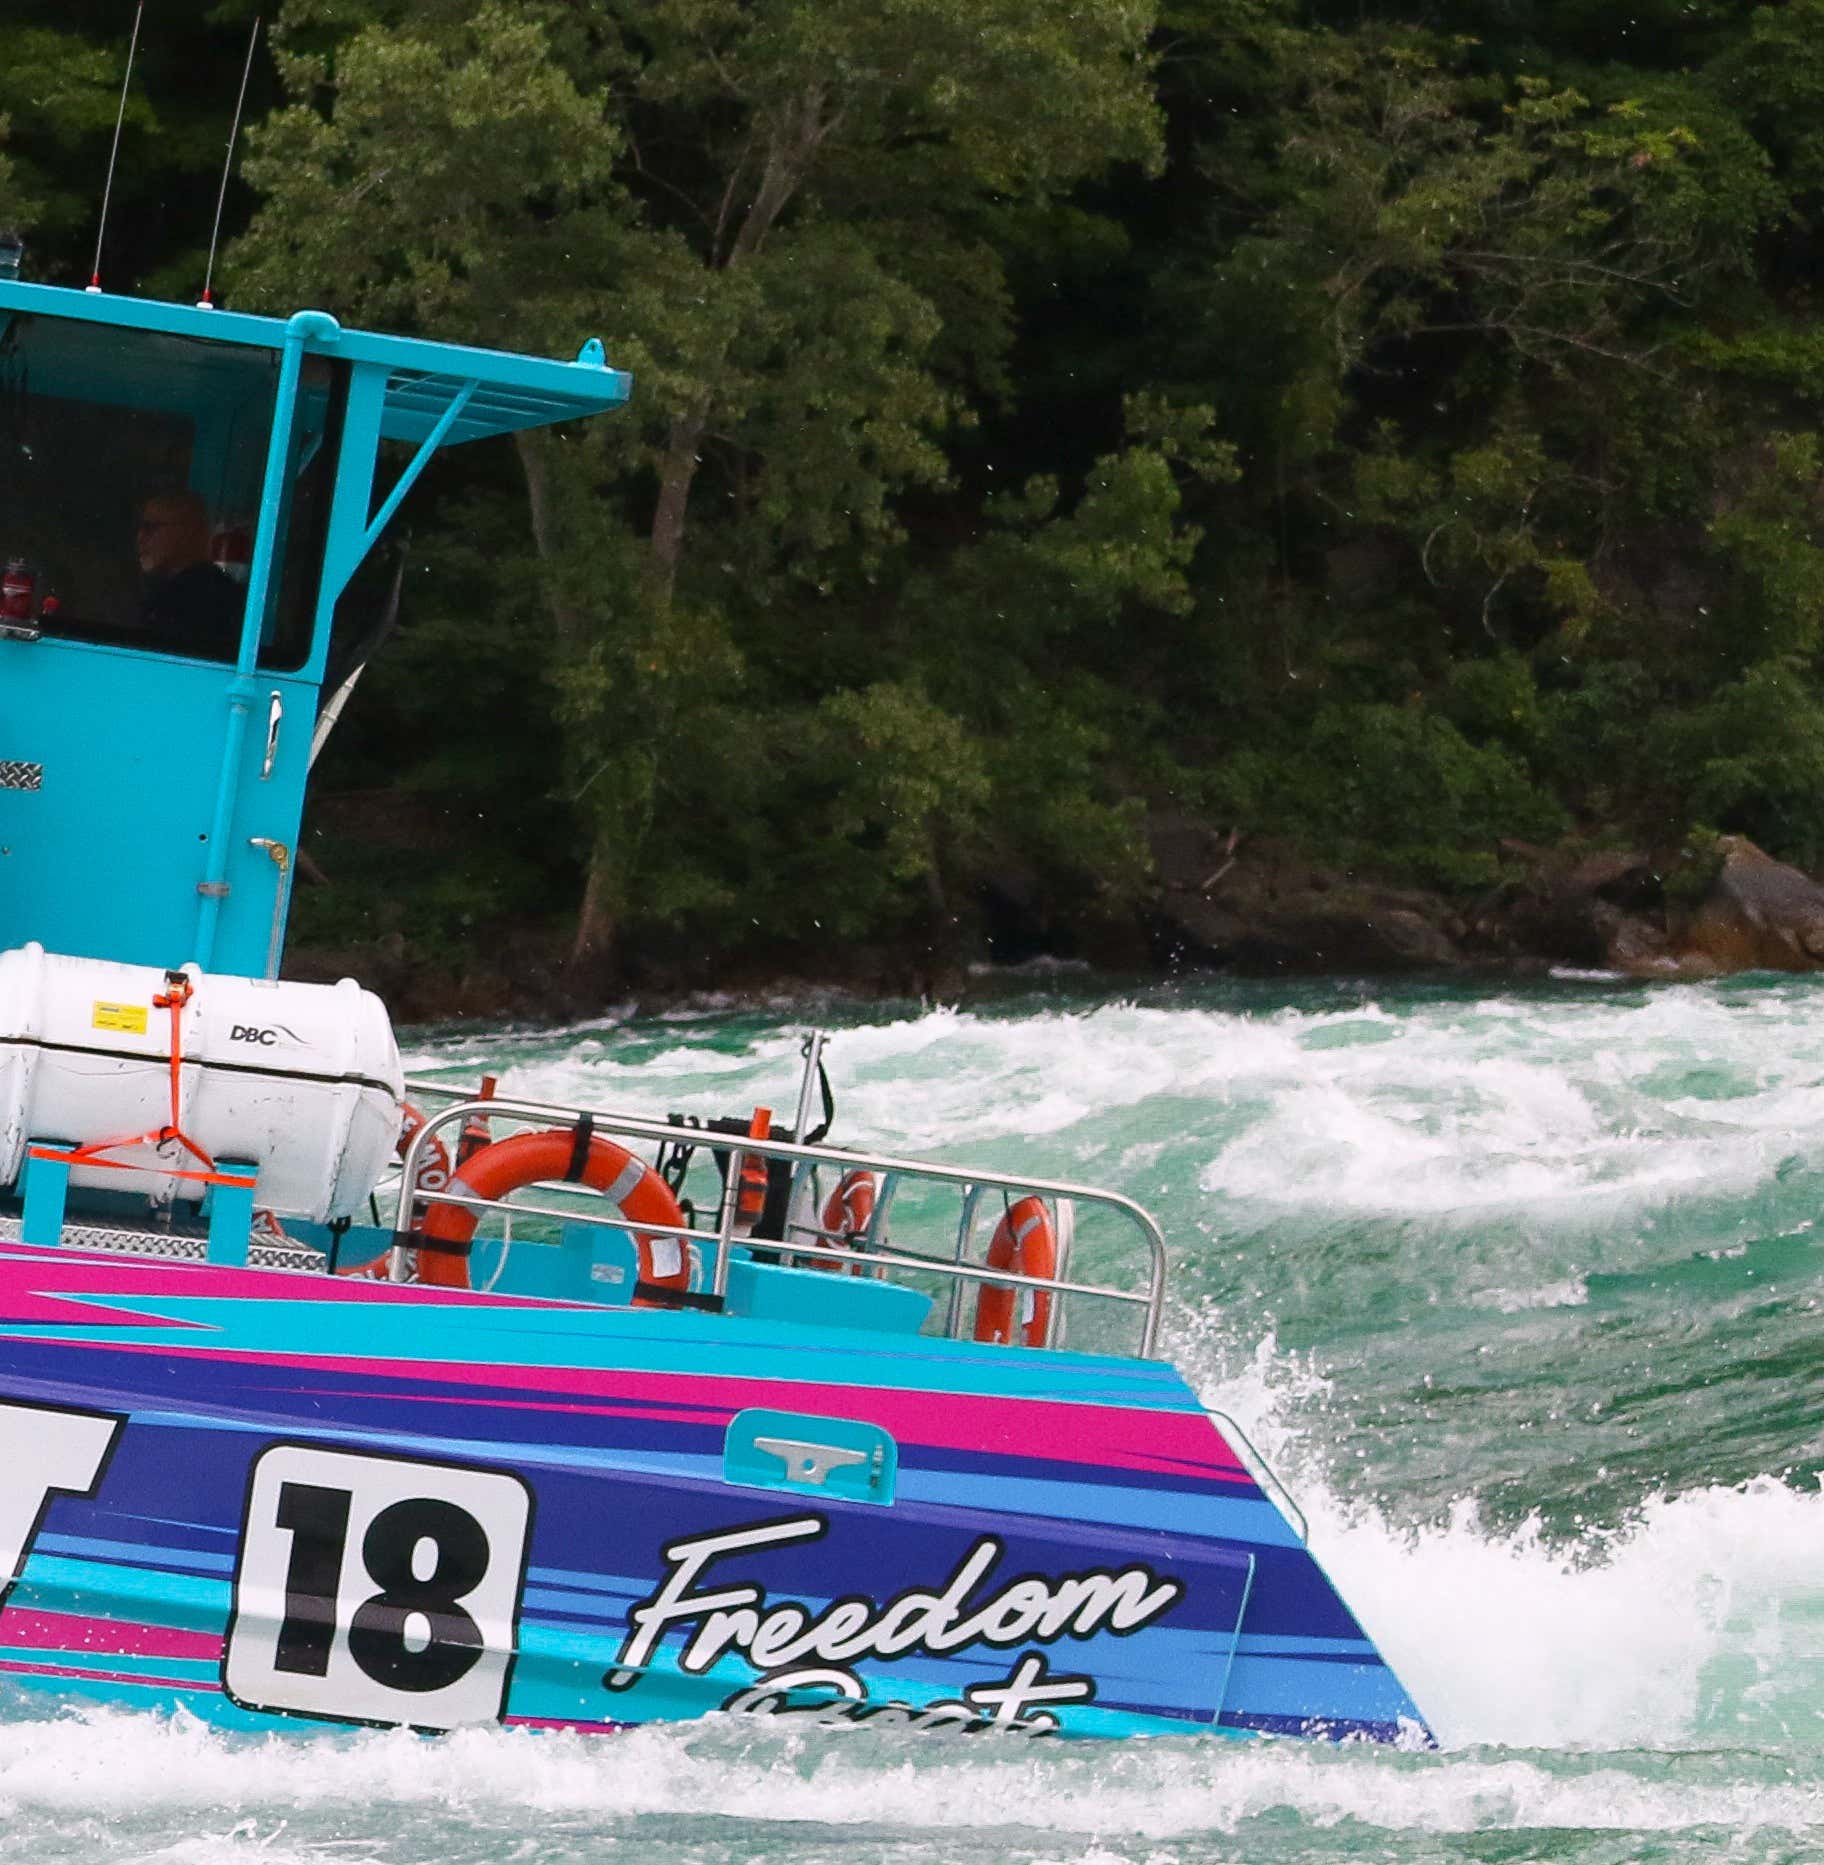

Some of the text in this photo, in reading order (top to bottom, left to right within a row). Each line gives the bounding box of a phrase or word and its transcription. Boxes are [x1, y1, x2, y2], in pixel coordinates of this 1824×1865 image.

[229, 1024, 279, 1047] DBC
[273, 1481, 490, 1693] 18
[602, 1513, 1181, 1690] Freedom
